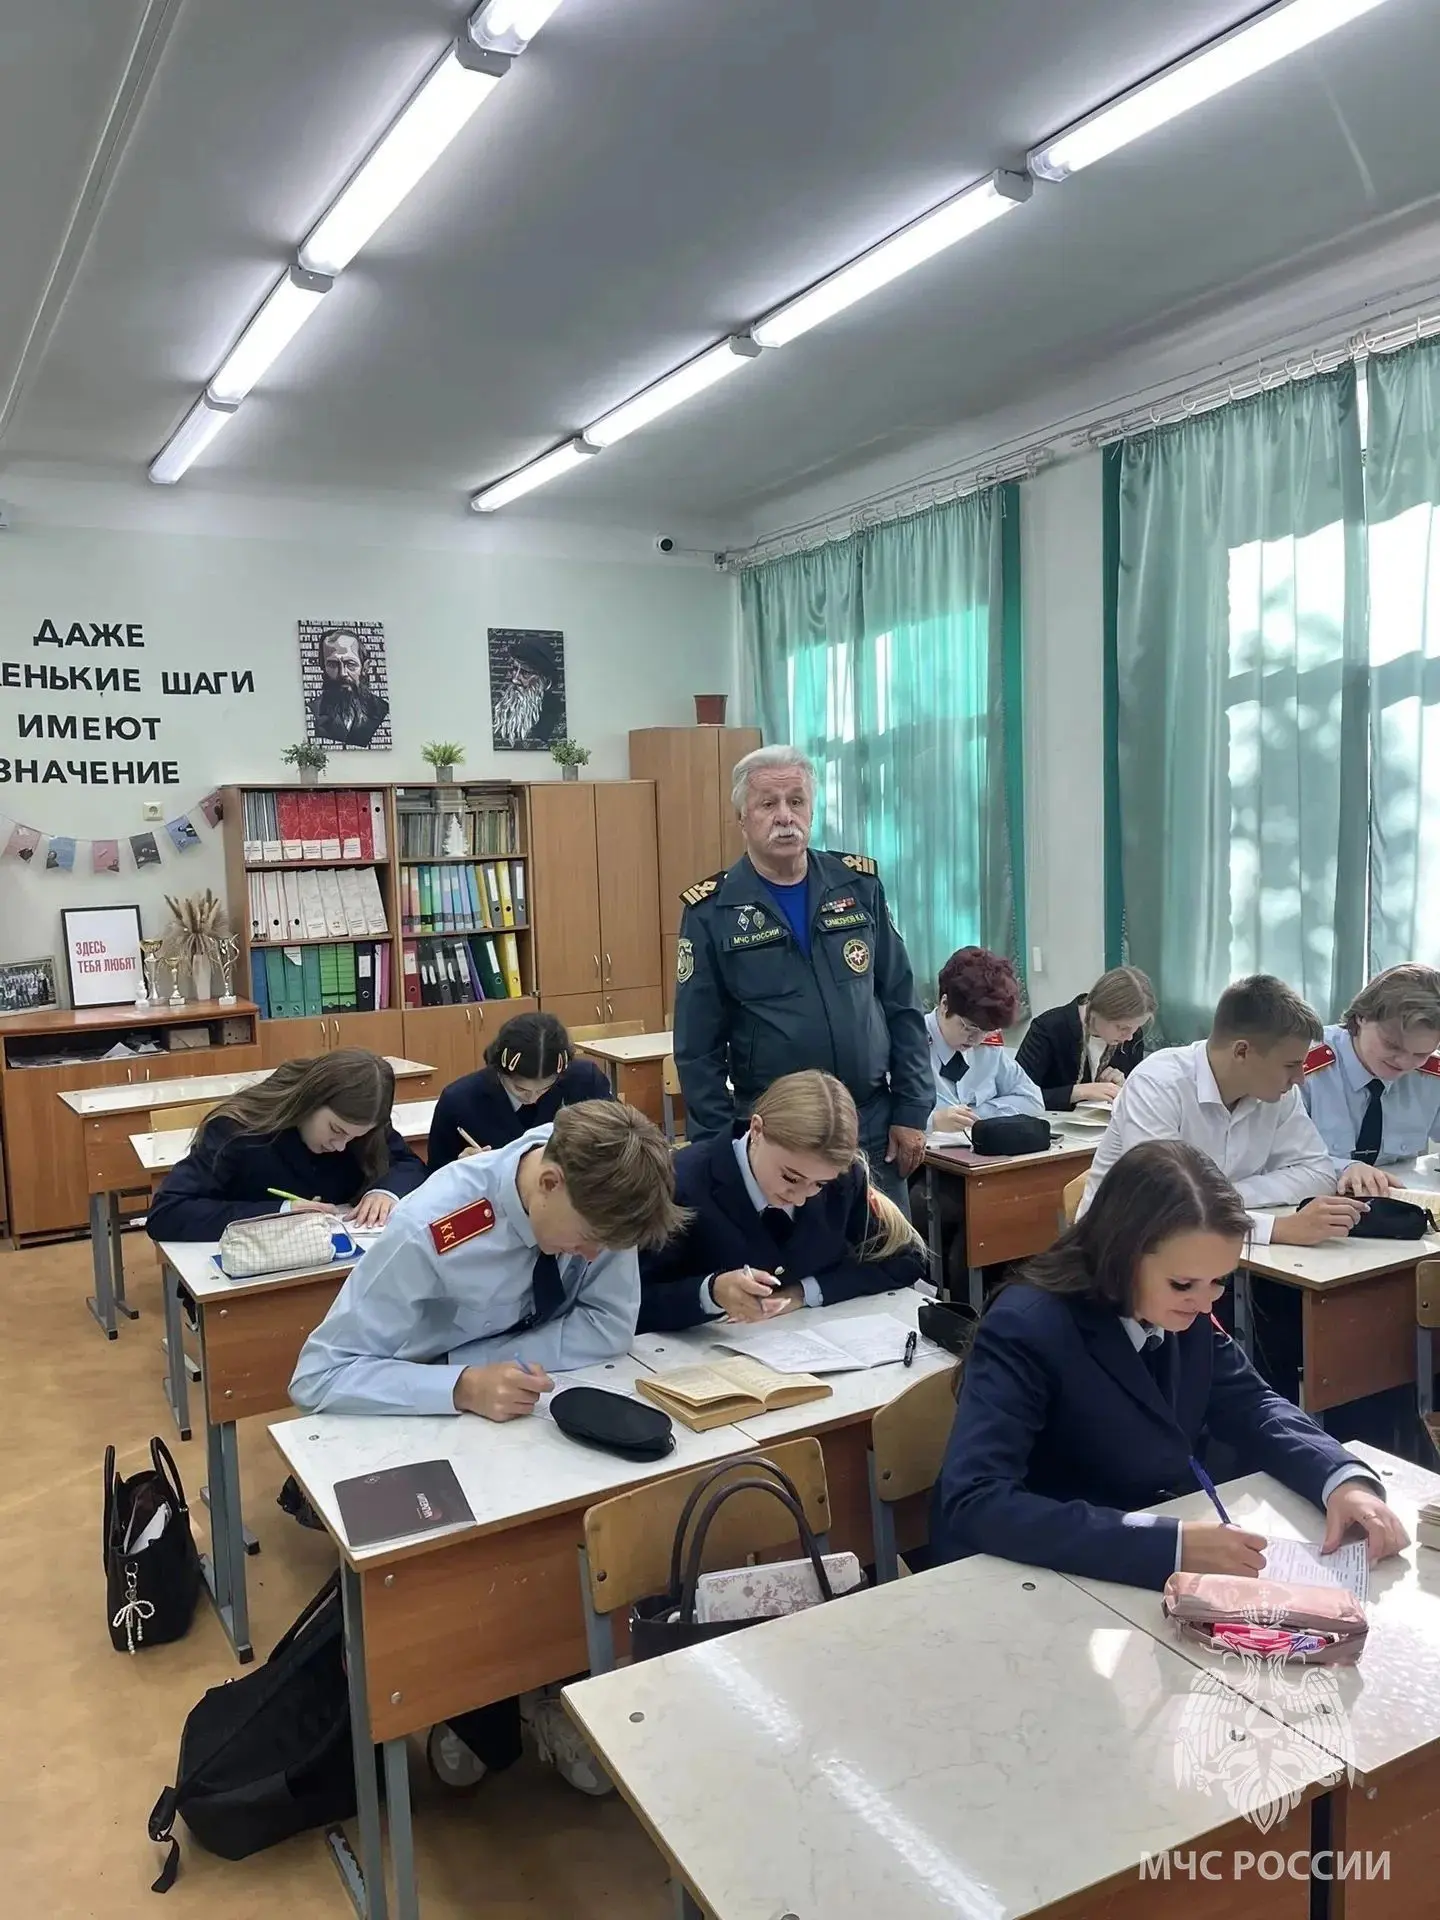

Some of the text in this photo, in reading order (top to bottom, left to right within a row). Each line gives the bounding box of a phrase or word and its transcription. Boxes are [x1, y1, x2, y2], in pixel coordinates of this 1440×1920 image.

[33, 619, 144, 647] ДАЖЕ
[0, 663, 254, 694] ЕНЬКИЕ ШАГИ
[18, 714, 160, 740] ИМЕЮТ
[0, 759, 179, 784] ЗНАЧЕНИЕ
[75, 941, 106, 956] ЗДЕСЬ
[733, 928, 779, 944] МЧС РОССИИ
[77, 957, 136, 973] ТЕБЯ ЛЮБЯТ
